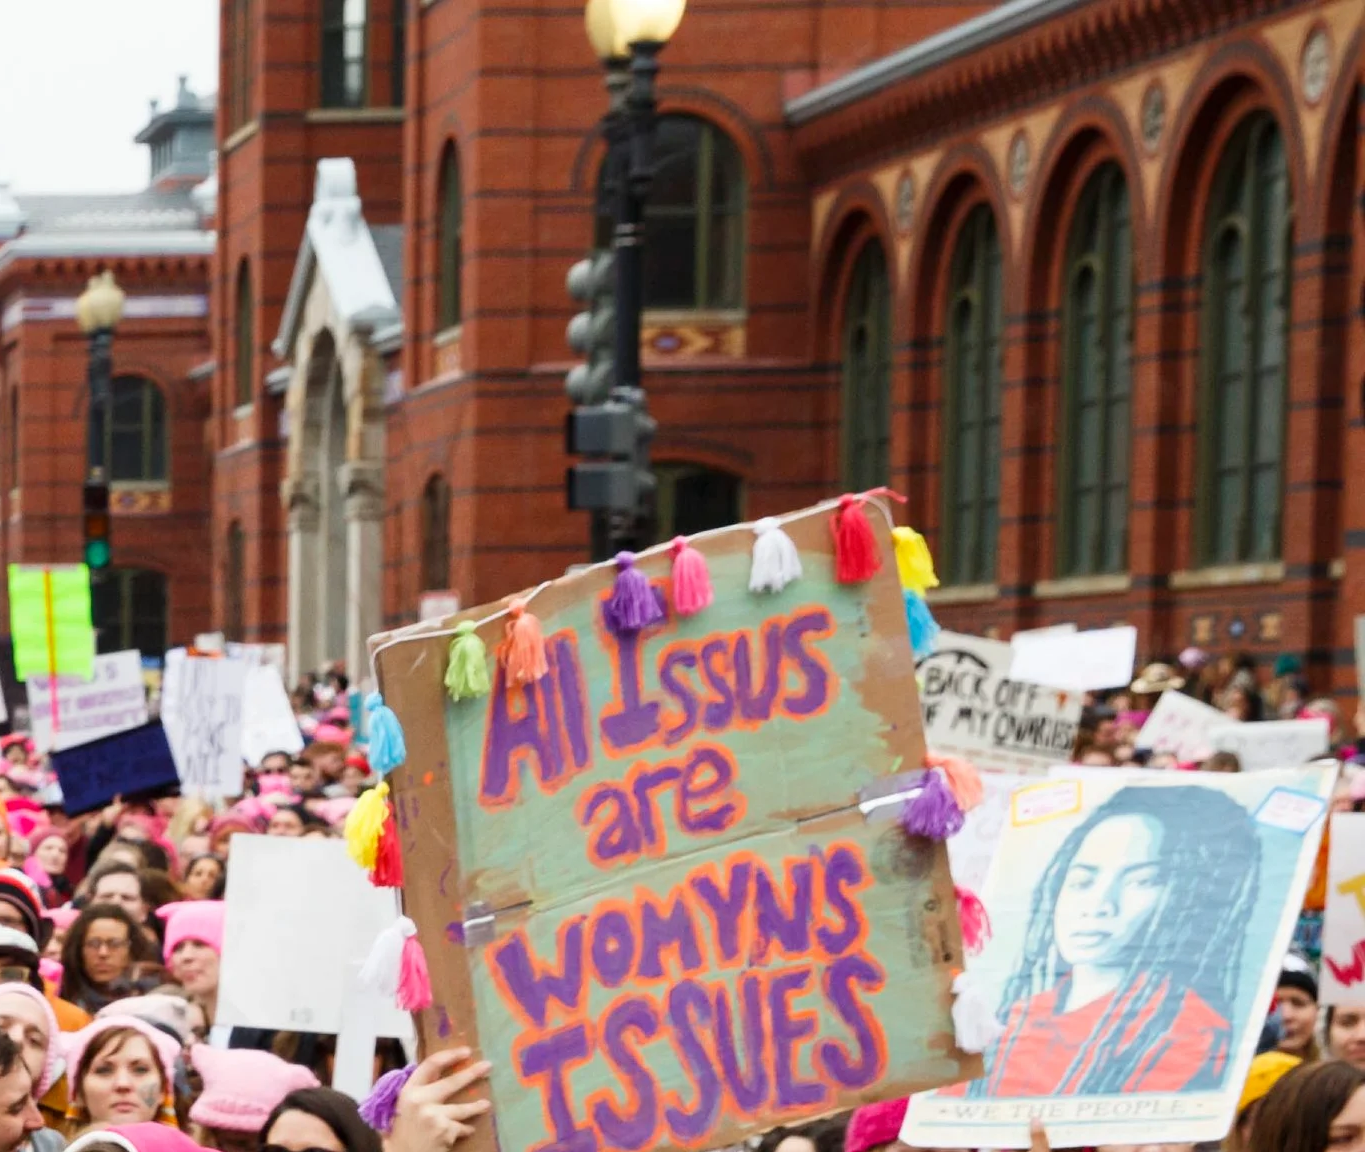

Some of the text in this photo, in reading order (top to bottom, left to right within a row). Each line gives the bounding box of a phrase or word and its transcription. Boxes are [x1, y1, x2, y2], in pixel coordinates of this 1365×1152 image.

[925, 666, 989, 704] BACK
[950, 706, 992, 737] MY
[579, 741, 747, 868] are
[954, 1099, 1188, 1120] WE THE PEOPLE
